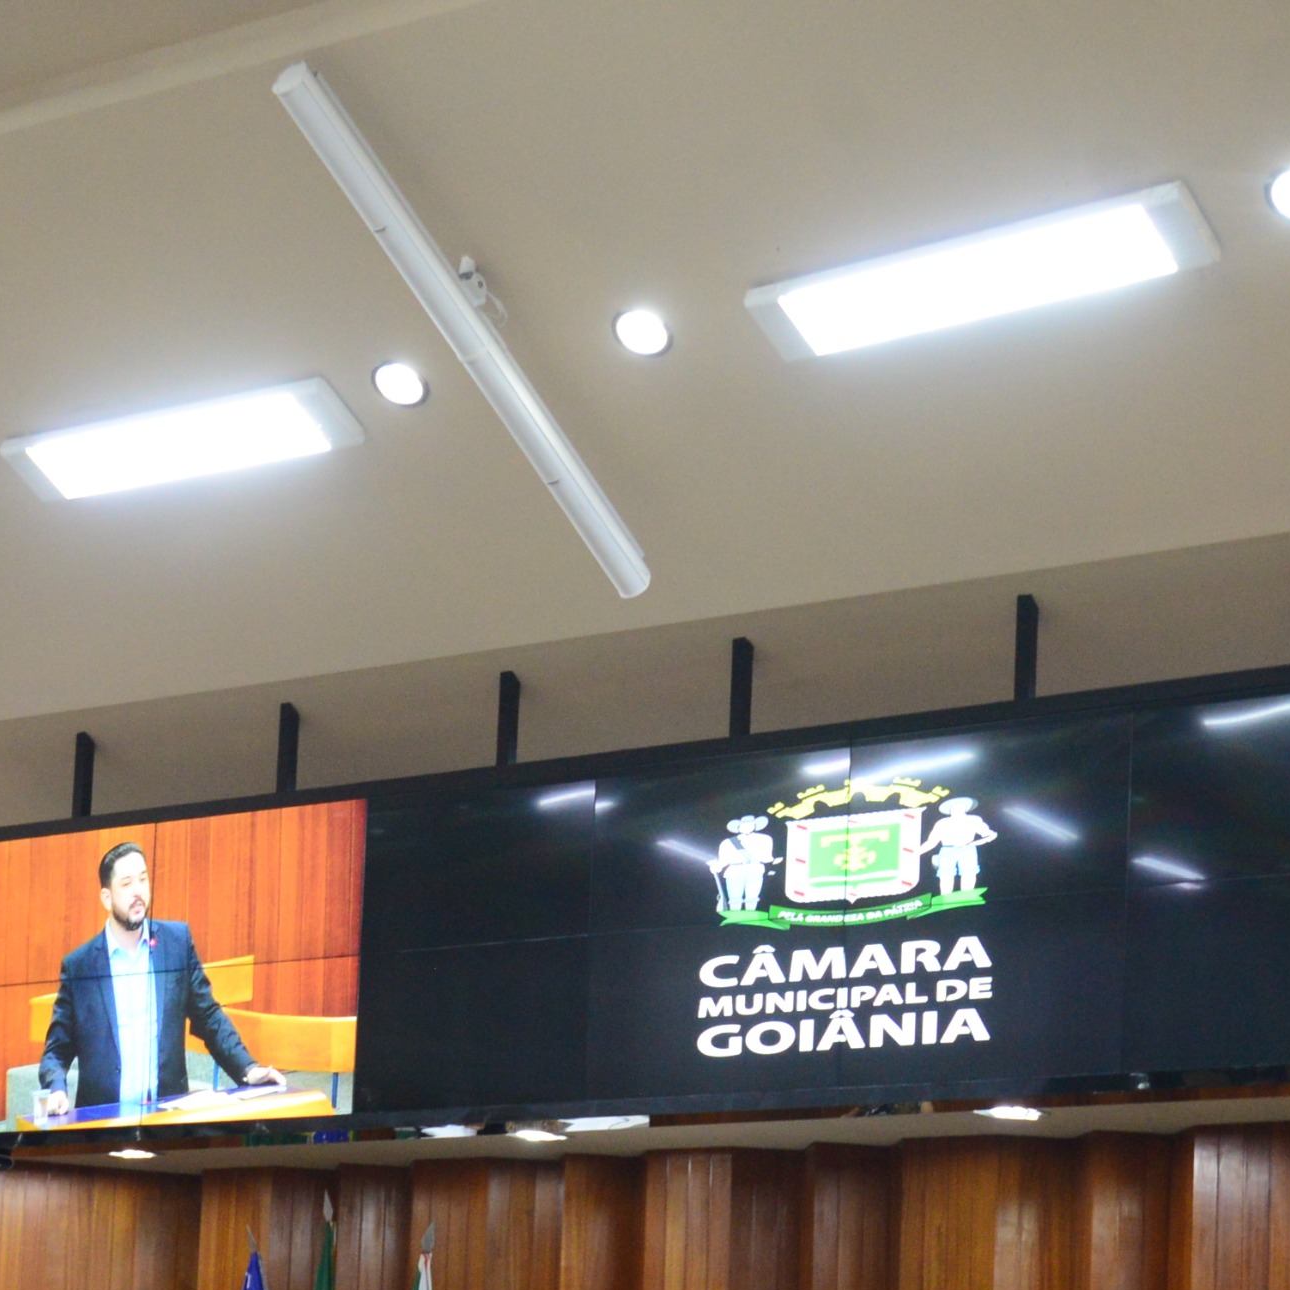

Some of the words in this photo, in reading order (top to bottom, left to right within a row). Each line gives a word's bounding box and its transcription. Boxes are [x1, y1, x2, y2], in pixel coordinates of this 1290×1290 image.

[698, 935, 993, 989] CÂMARA
[697, 981, 929, 1019] MUNICIPAL
[935, 976, 993, 1003] DE
[696, 1008, 991, 1058] GOIÂNIA
